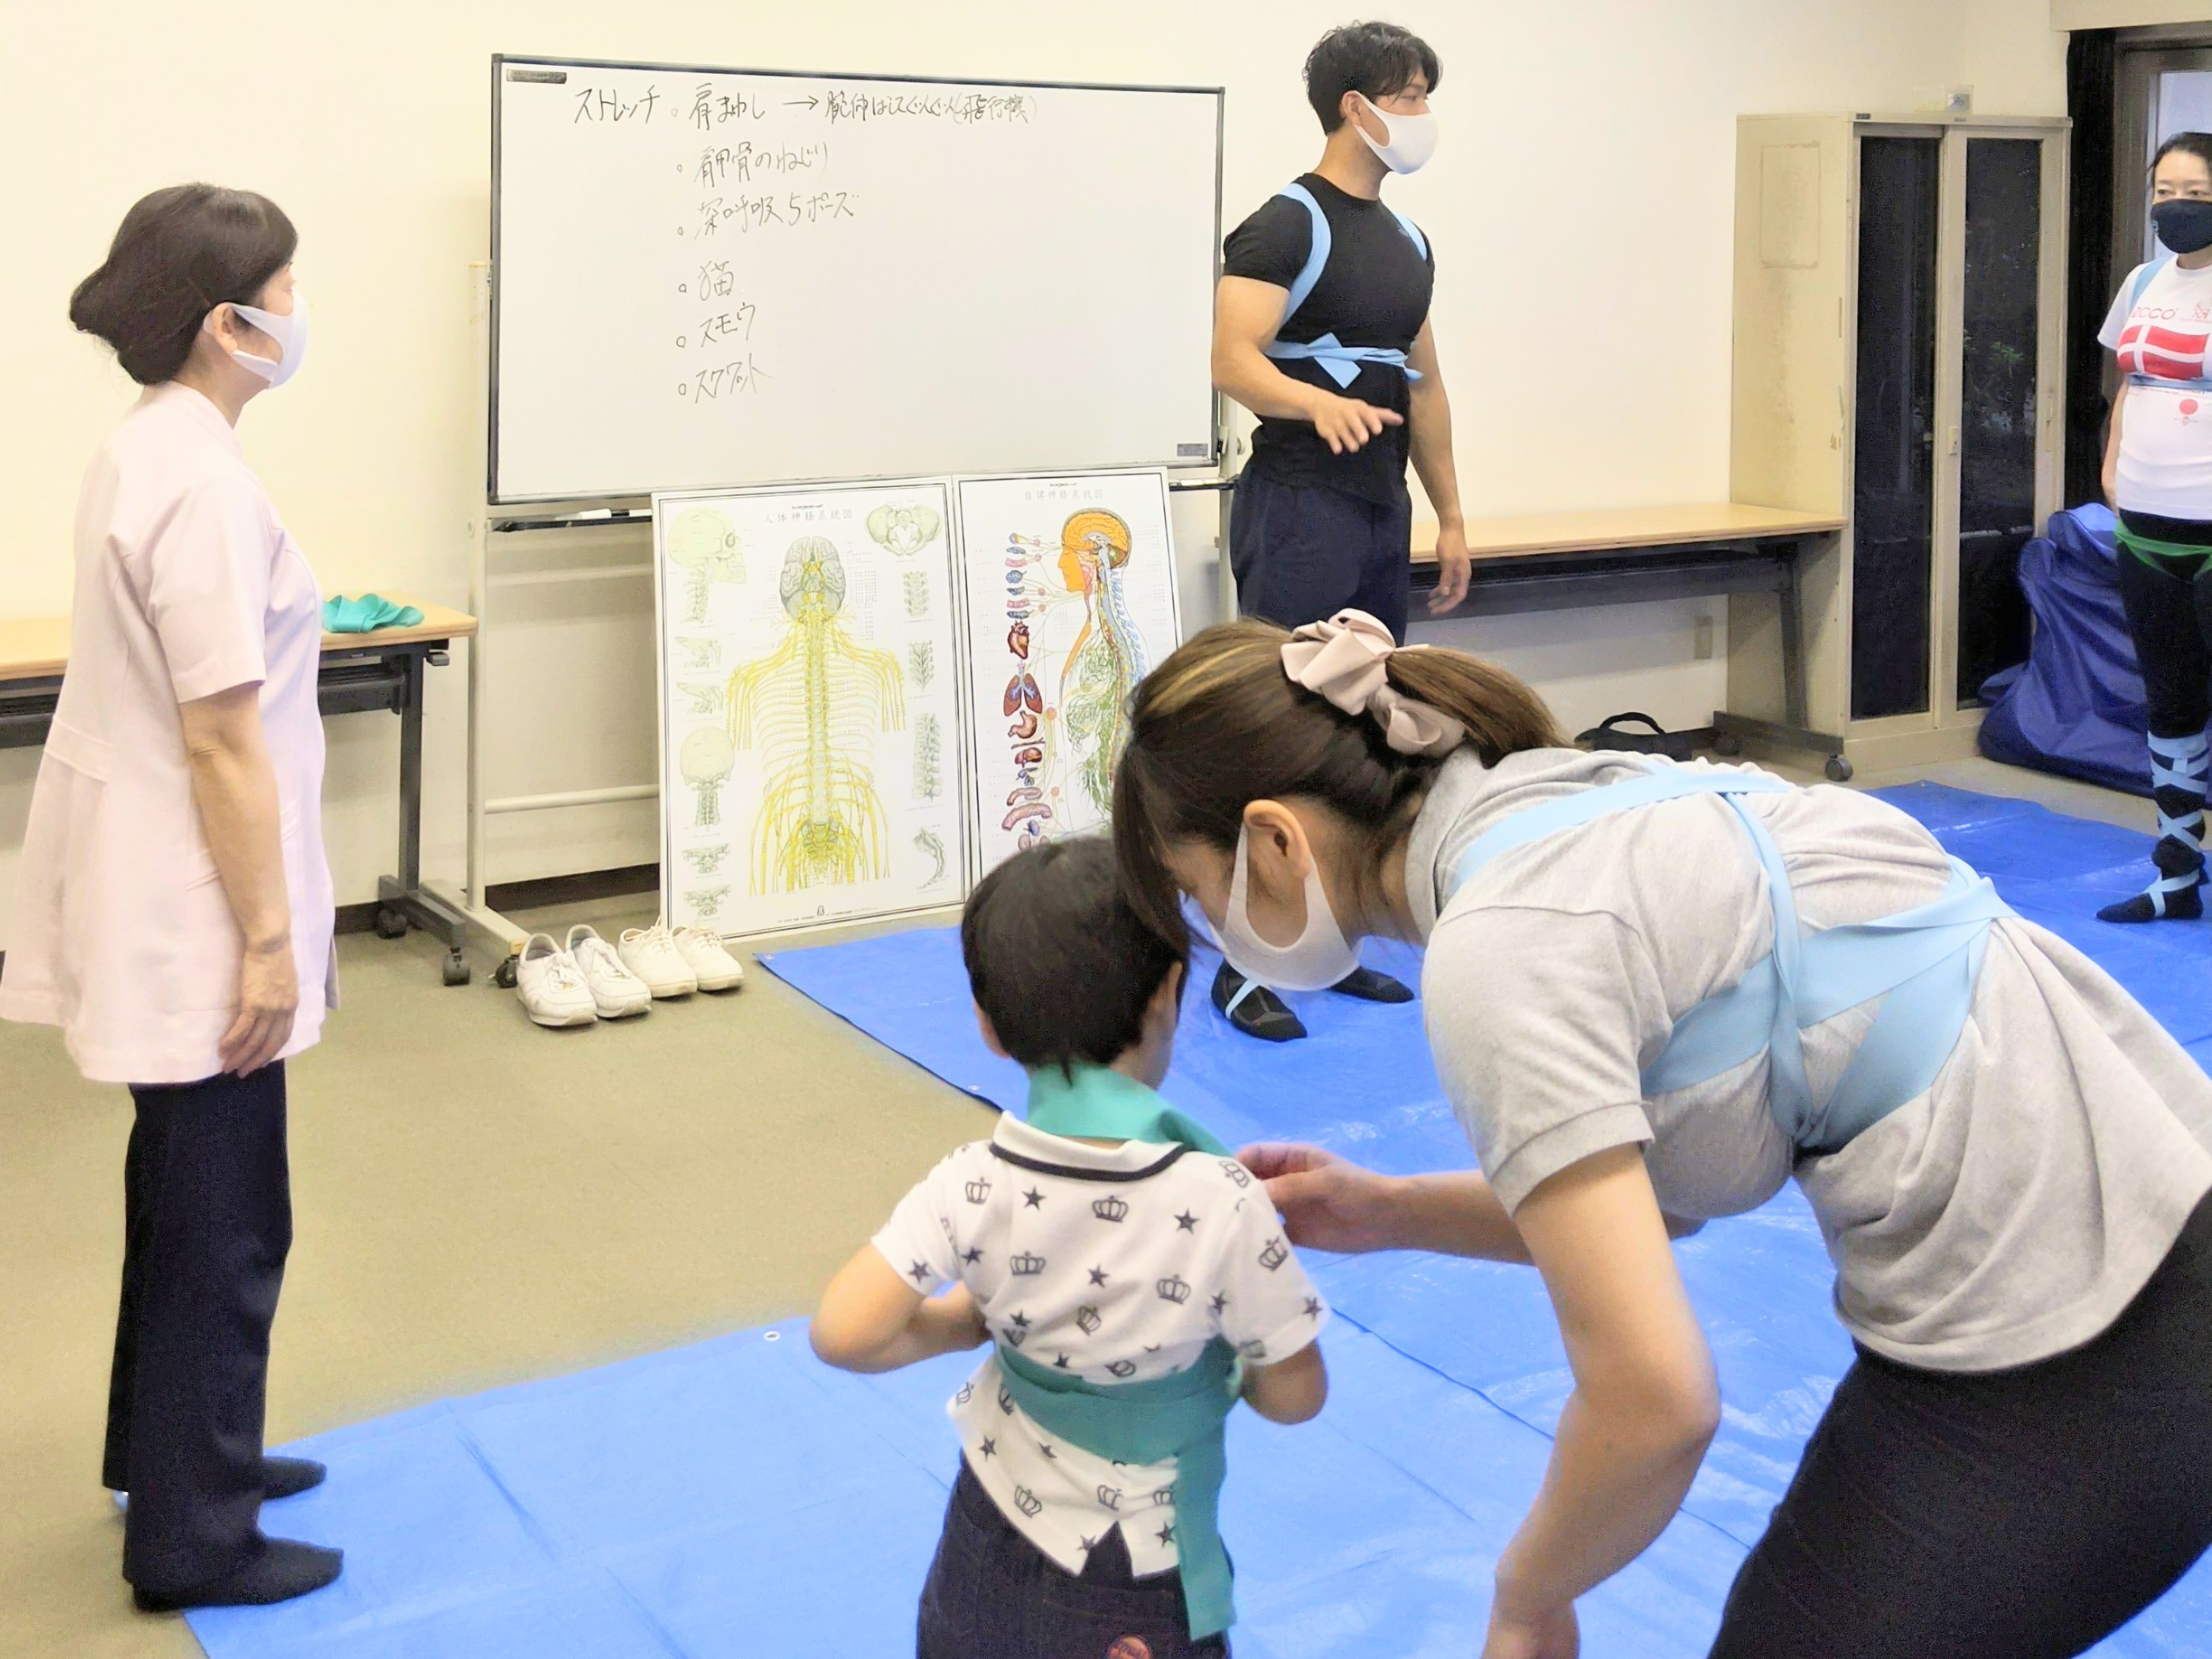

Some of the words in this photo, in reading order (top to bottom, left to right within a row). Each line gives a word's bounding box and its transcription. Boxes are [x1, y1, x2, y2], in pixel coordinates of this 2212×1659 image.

[575, 85, 661, 124] ストレッチ
[689, 83, 765, 131] 肩まわし
[694, 142, 828, 188] 肩甲骨のねじり
[699, 261, 734, 301] 猫
[699, 303, 756, 348] スモウ
[695, 353, 776, 403] スクワット
